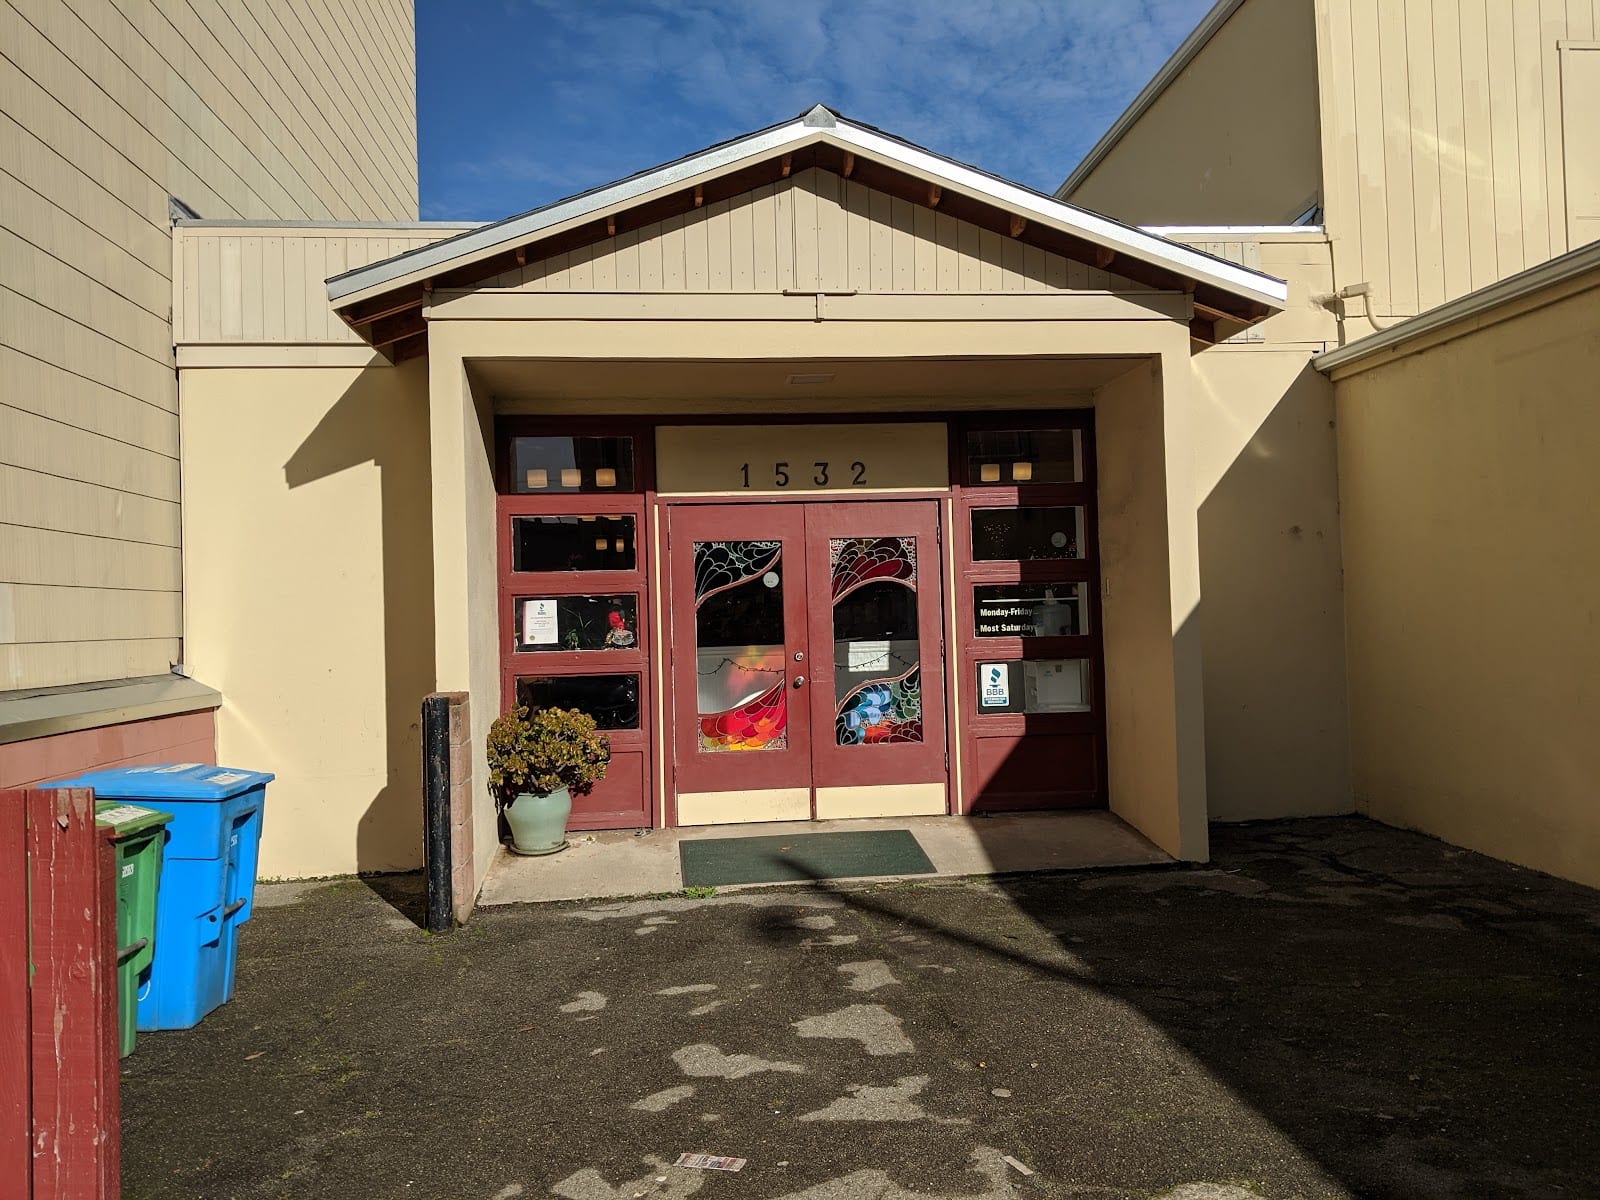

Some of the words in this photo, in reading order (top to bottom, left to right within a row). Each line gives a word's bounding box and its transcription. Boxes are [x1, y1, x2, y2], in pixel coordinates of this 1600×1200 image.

[740, 461, 867, 487] 1532
[980, 607, 1033, 617] Monday-Friday
[980, 624, 999, 632] Most
[986, 688, 1005, 696] BBB
